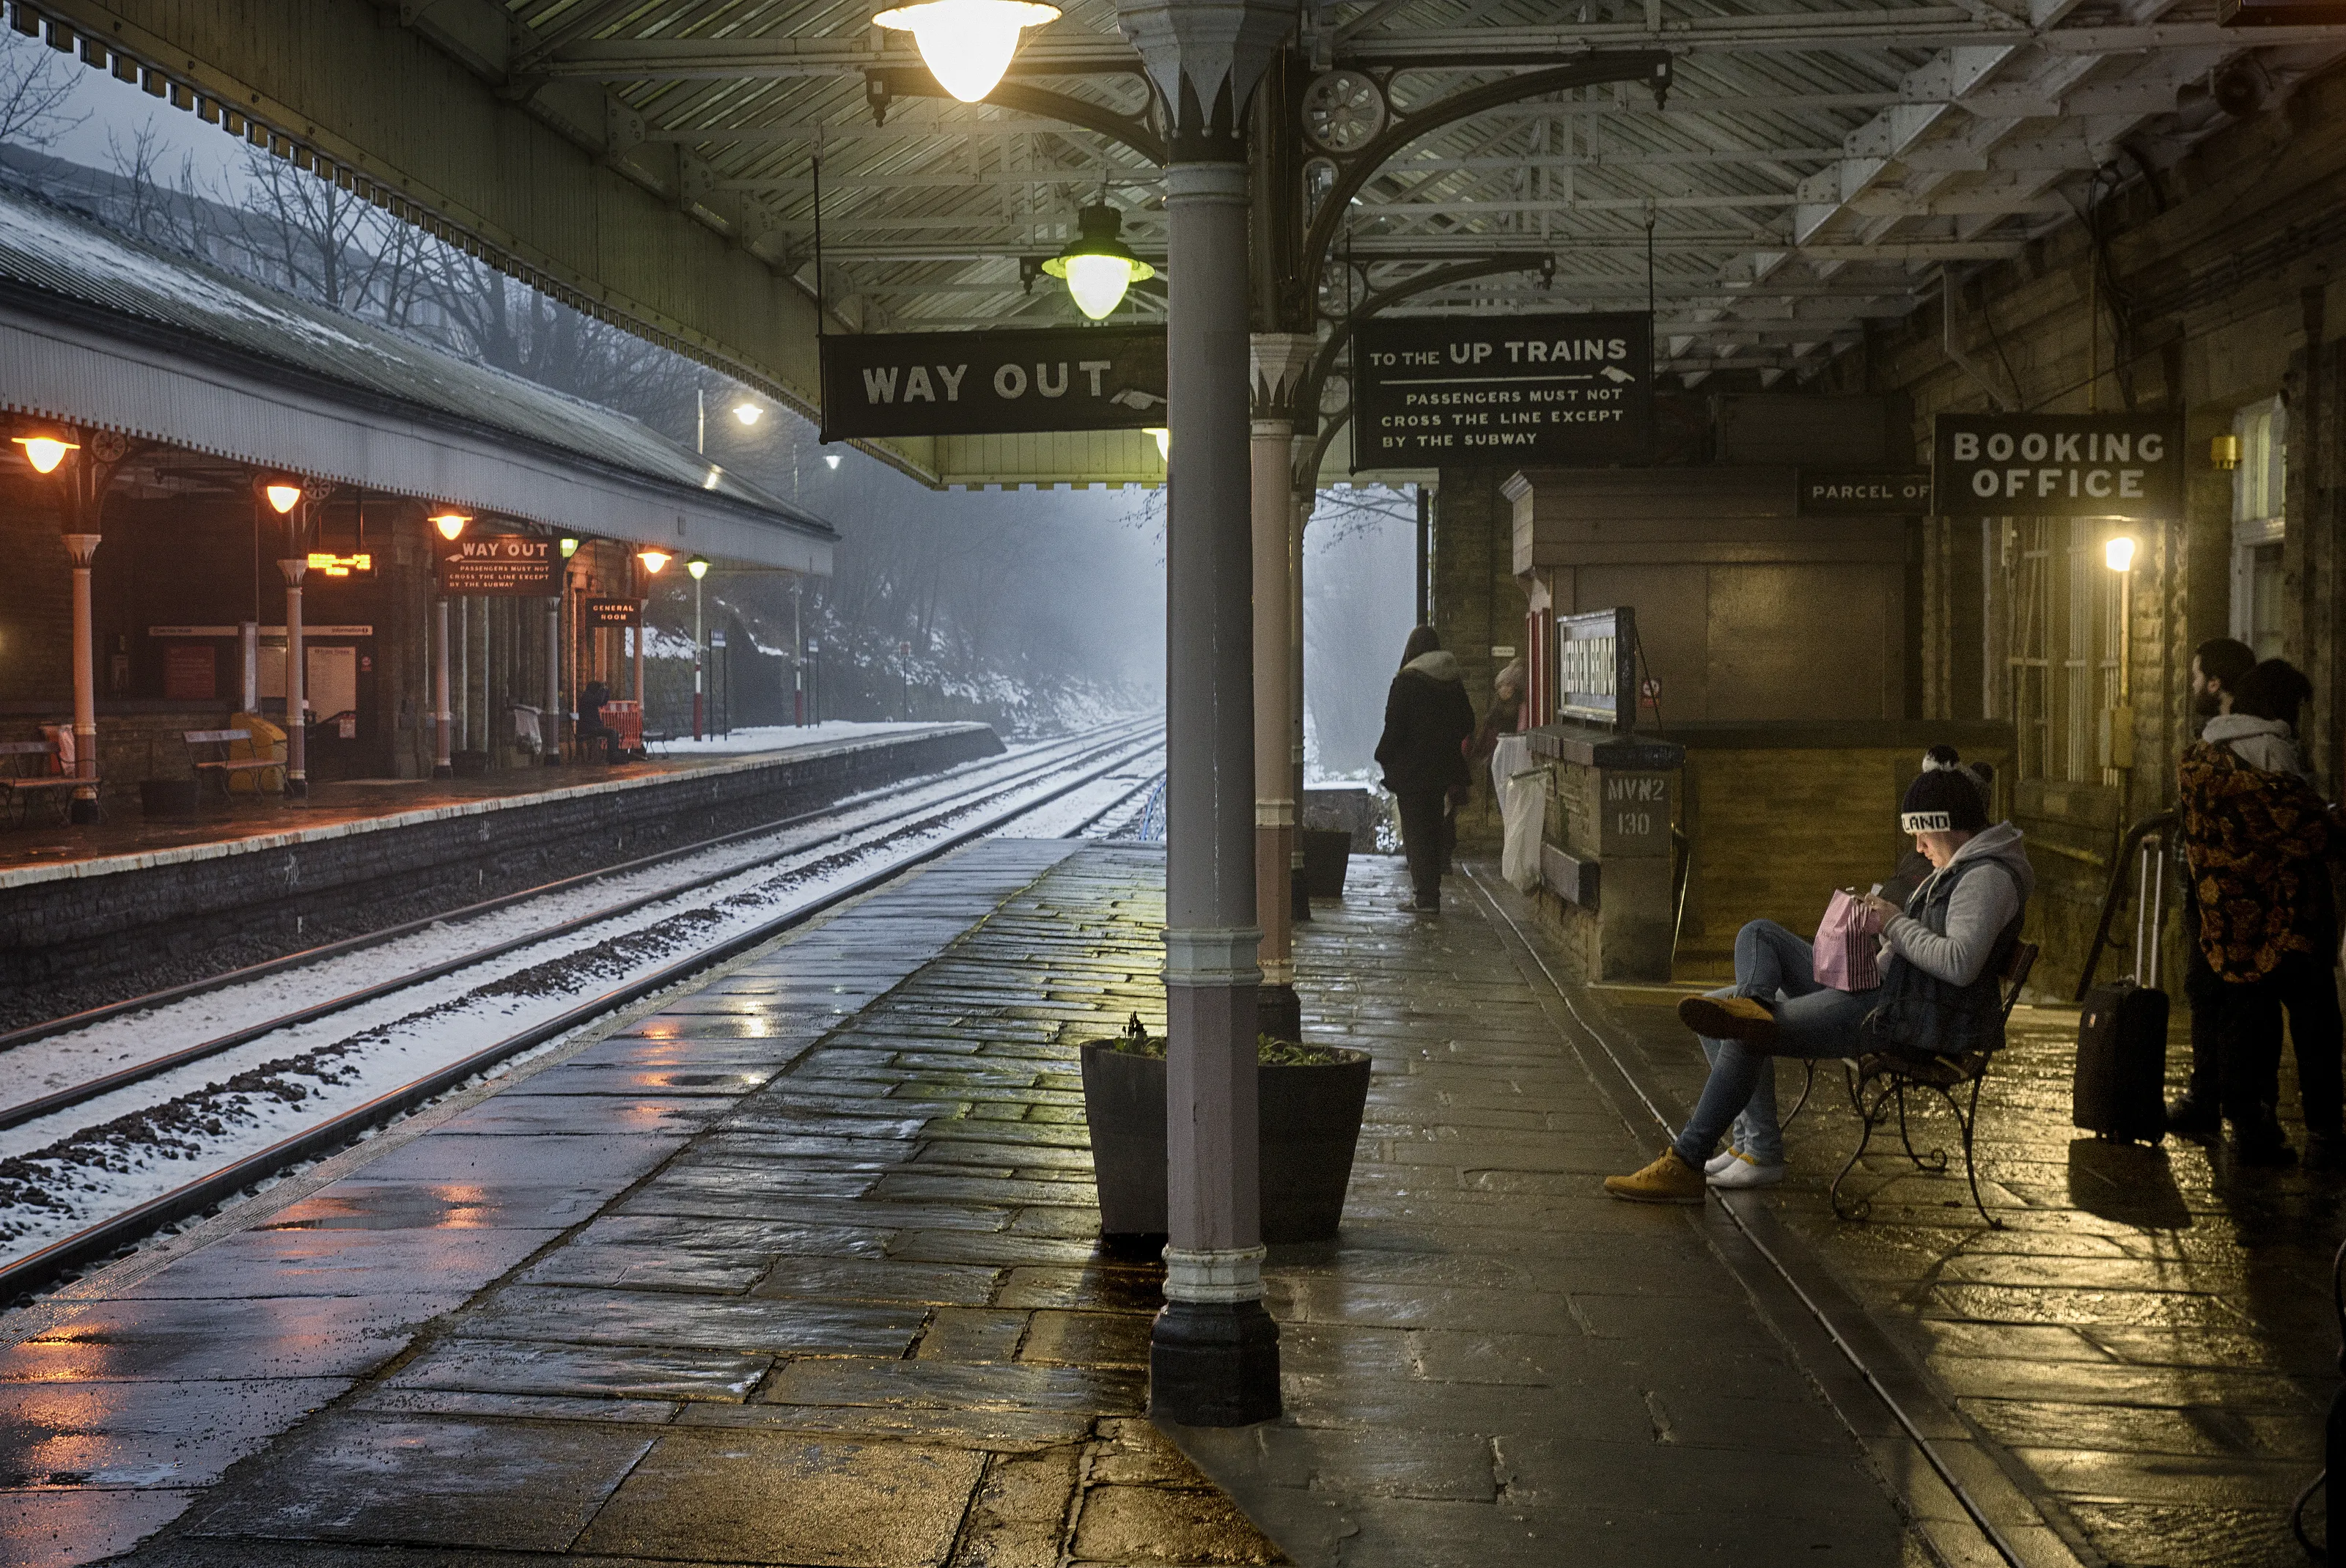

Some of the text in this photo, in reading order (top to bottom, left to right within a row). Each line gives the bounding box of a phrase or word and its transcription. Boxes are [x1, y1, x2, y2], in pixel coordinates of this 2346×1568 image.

[1369, 339, 1627, 367] TO THE UP TRAINS
[862, 361, 1111, 404] WAY OUT
[1406, 388, 1623, 405] PASSENGERS MUST NOT
[1381, 410, 1624, 427] CROSS THE LINE EXCEPT
[1383, 433, 1537, 449] BY THE SUBWAY
[1954, 433, 2164, 463] BOOKING
[1812, 485, 1893, 498] PARCEL
[1972, 468, 2145, 498] OFFICE
[463, 542, 548, 556] WAY OUT
[592, 604, 634, 612] GENERAL
[1562, 636, 1616, 696] HEBDEN BRIDG
[1618, 812, 1650, 836] 130
[1902, 814, 1949, 831] LAND
